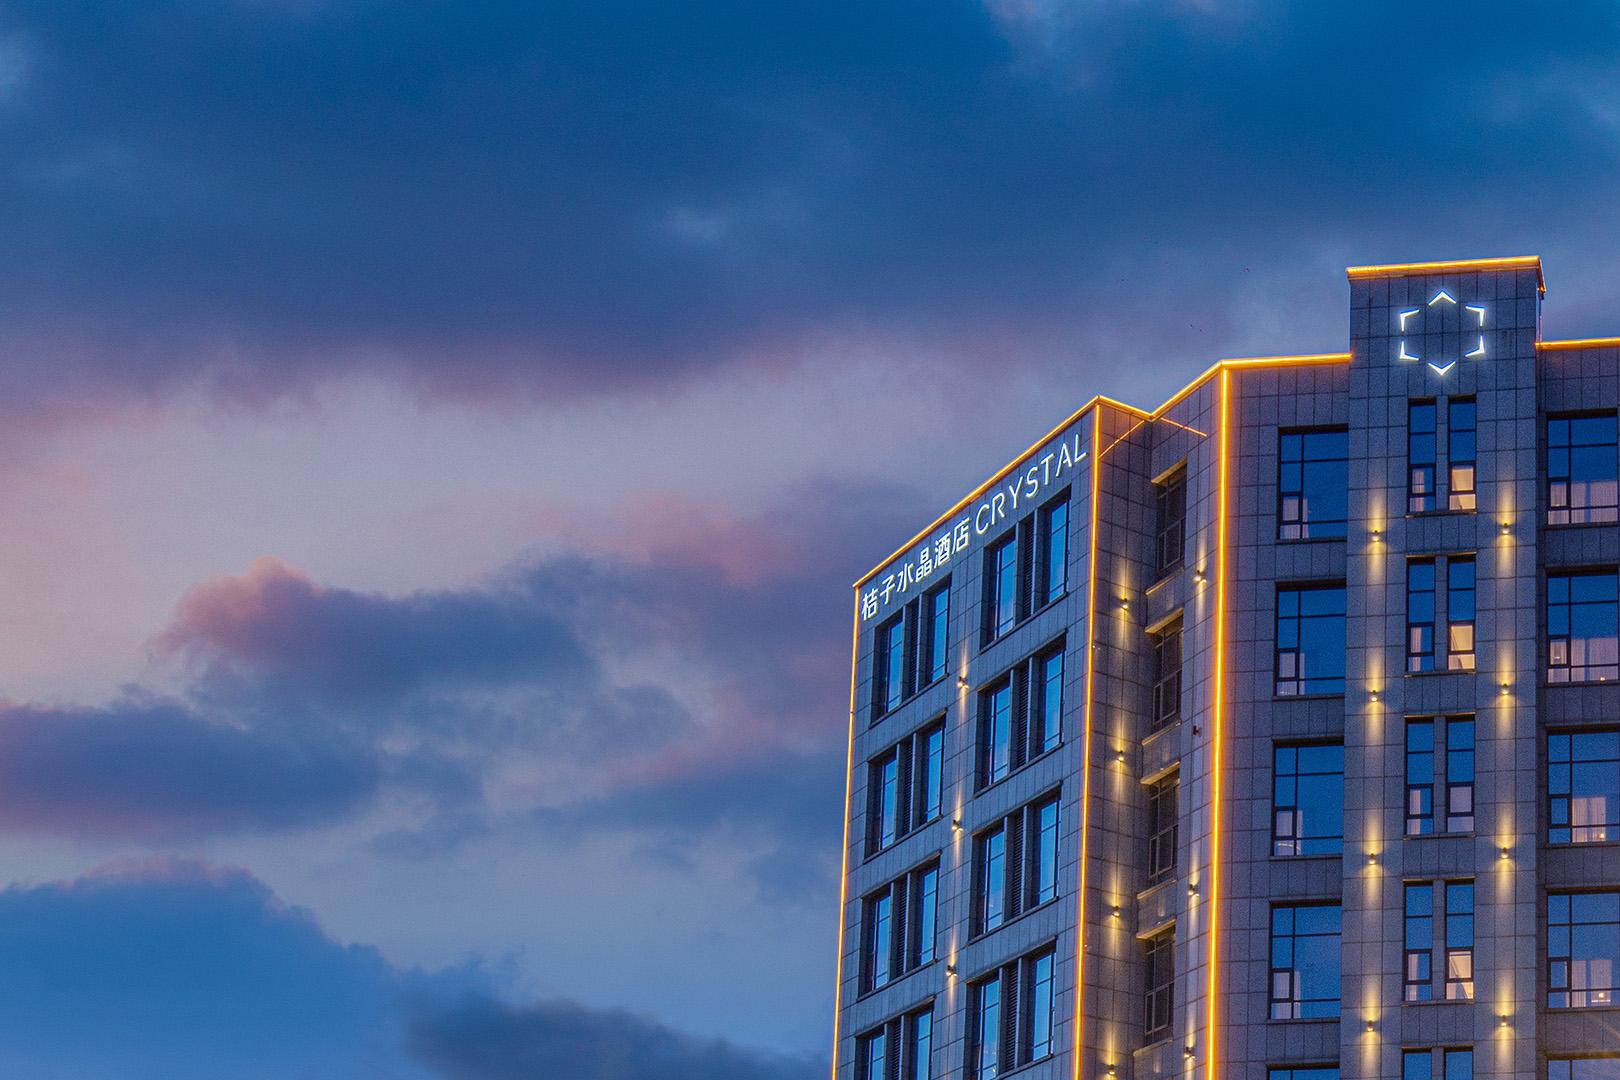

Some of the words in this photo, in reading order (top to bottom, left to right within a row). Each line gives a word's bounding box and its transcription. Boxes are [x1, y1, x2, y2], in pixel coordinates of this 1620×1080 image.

[861, 516, 970, 622] 桔子水晶酒店
[975, 433, 1087, 535] CRYSTAL
